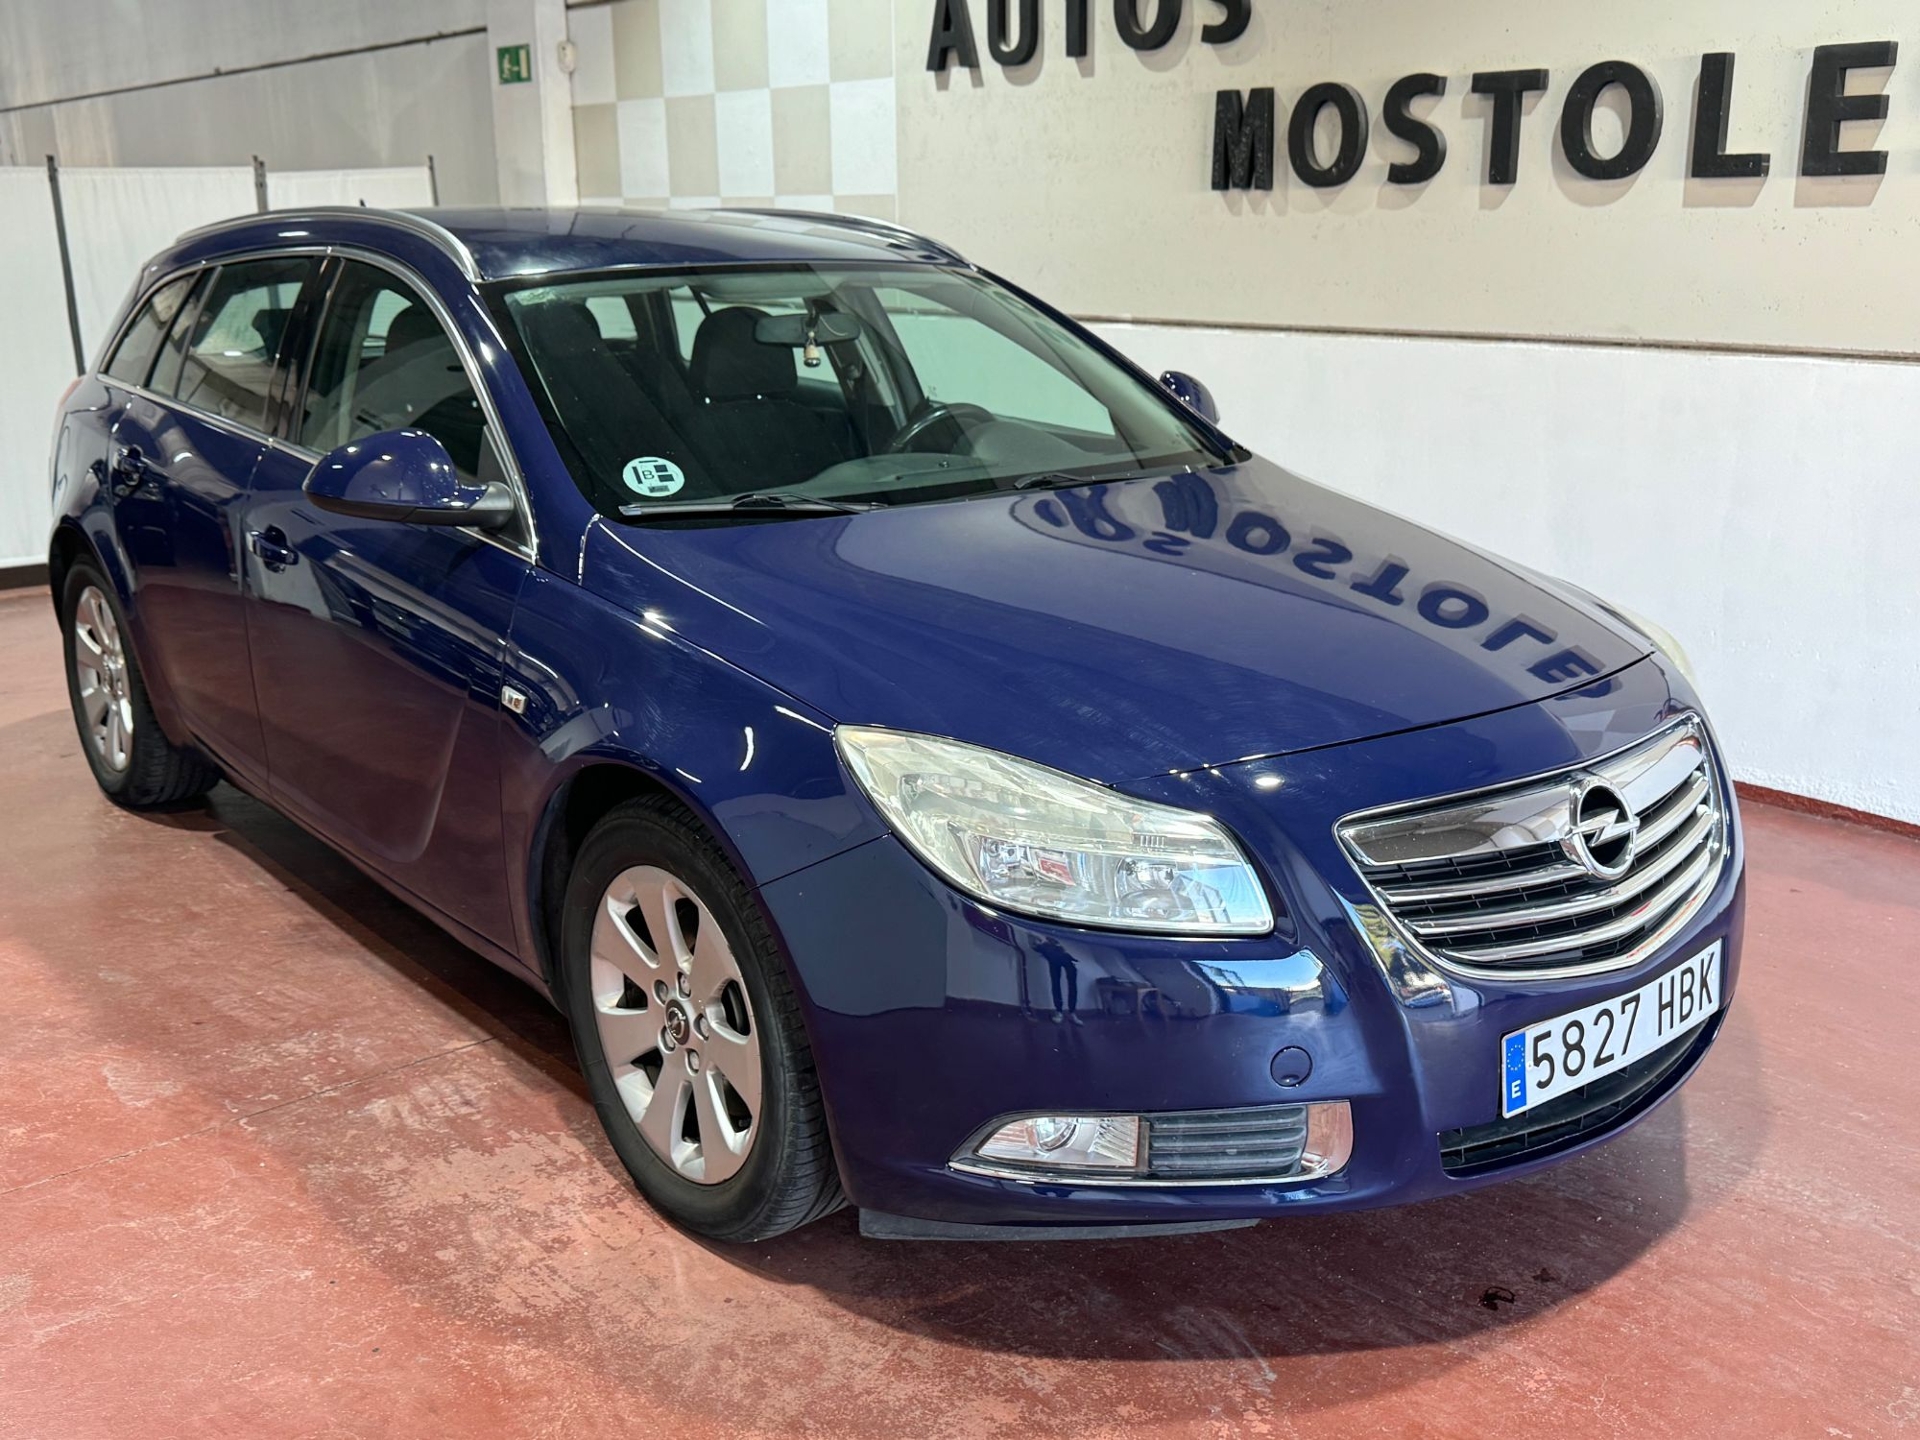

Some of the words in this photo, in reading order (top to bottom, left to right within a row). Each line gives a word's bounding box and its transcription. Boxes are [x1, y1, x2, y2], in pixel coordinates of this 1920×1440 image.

[1211, 41, 1899, 191] MOSTOLE
[642, 470, 655, 479] B
[1533, 993, 1641, 1089] 5827
[1658, 951, 1715, 1037] HBK
[1511, 1080, 1522, 1099] E
